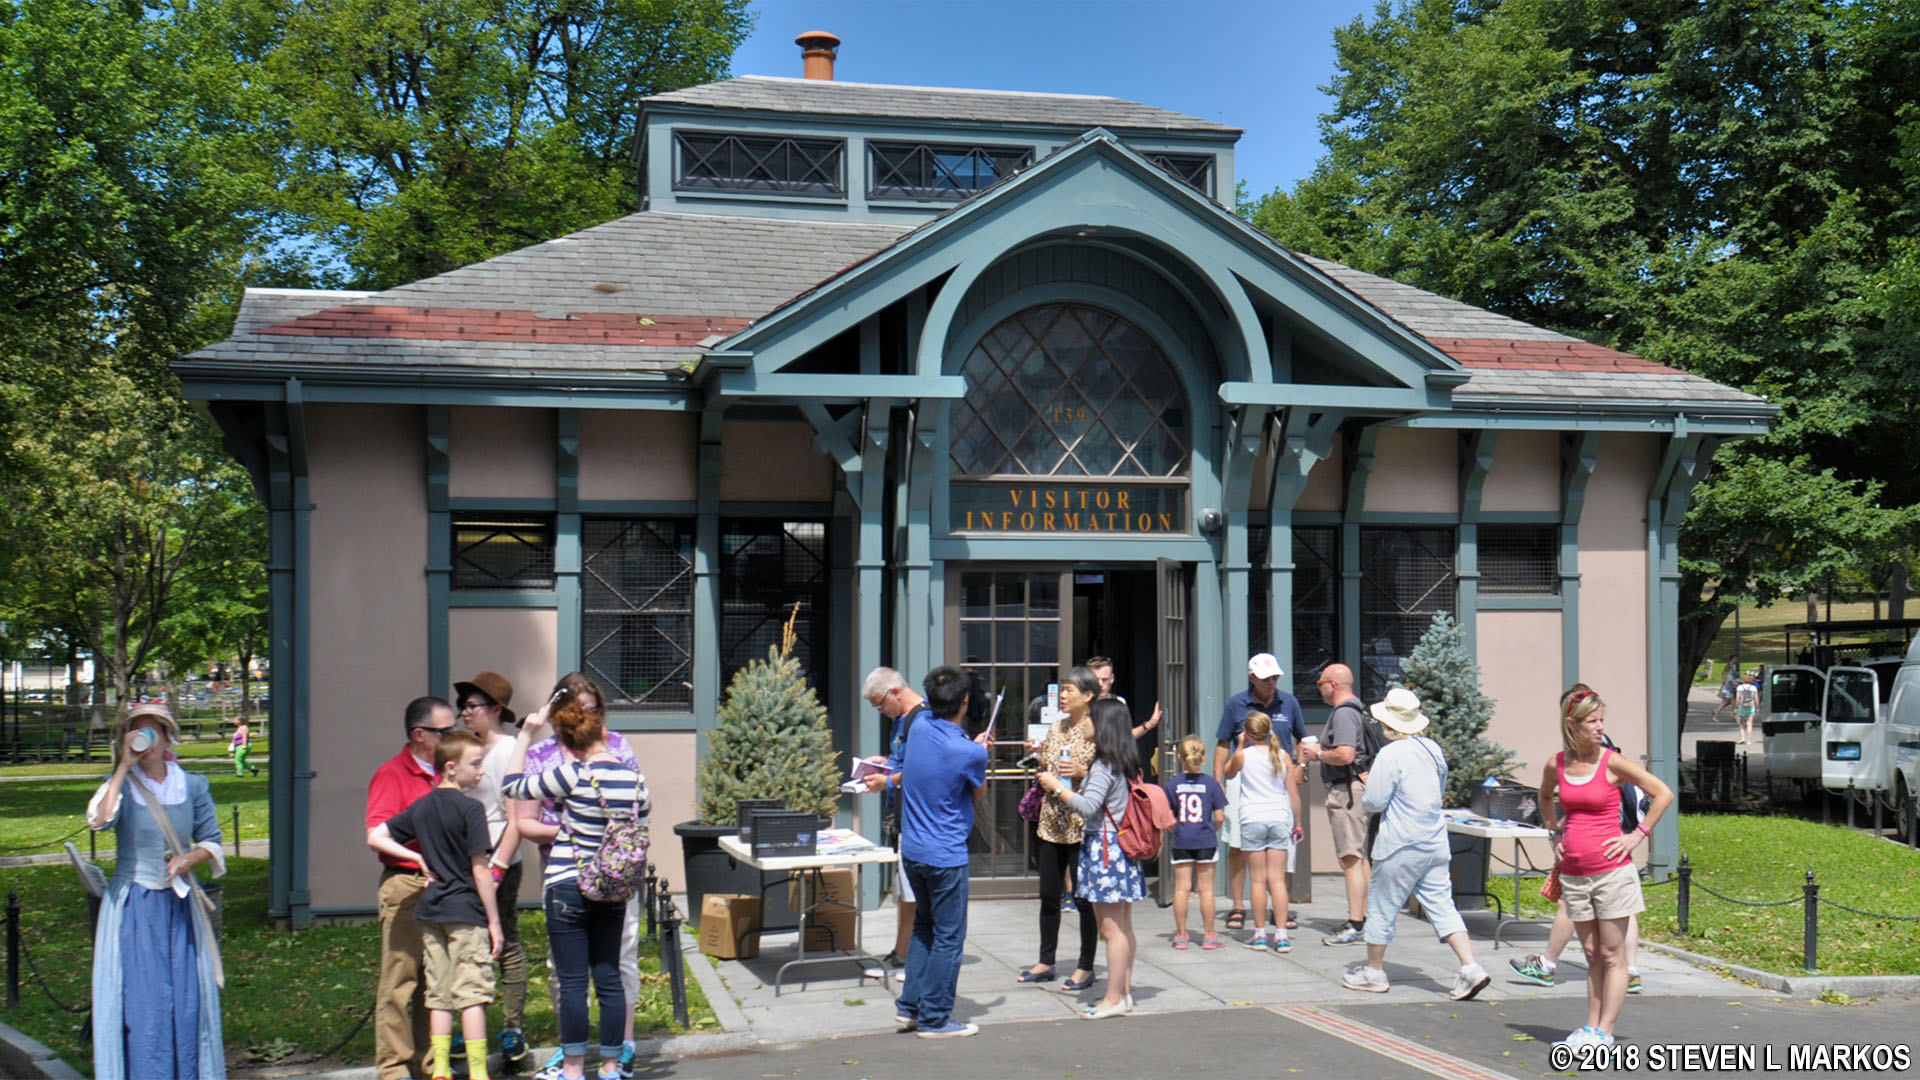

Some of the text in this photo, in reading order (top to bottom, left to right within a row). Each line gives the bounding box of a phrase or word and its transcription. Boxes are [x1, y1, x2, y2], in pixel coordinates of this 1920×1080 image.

[1053, 407, 1087, 425] 139
[1009, 489, 1131, 509] VISITOR
[966, 511, 1172, 532] INFORMATION
[1178, 793, 1203, 823] 19
